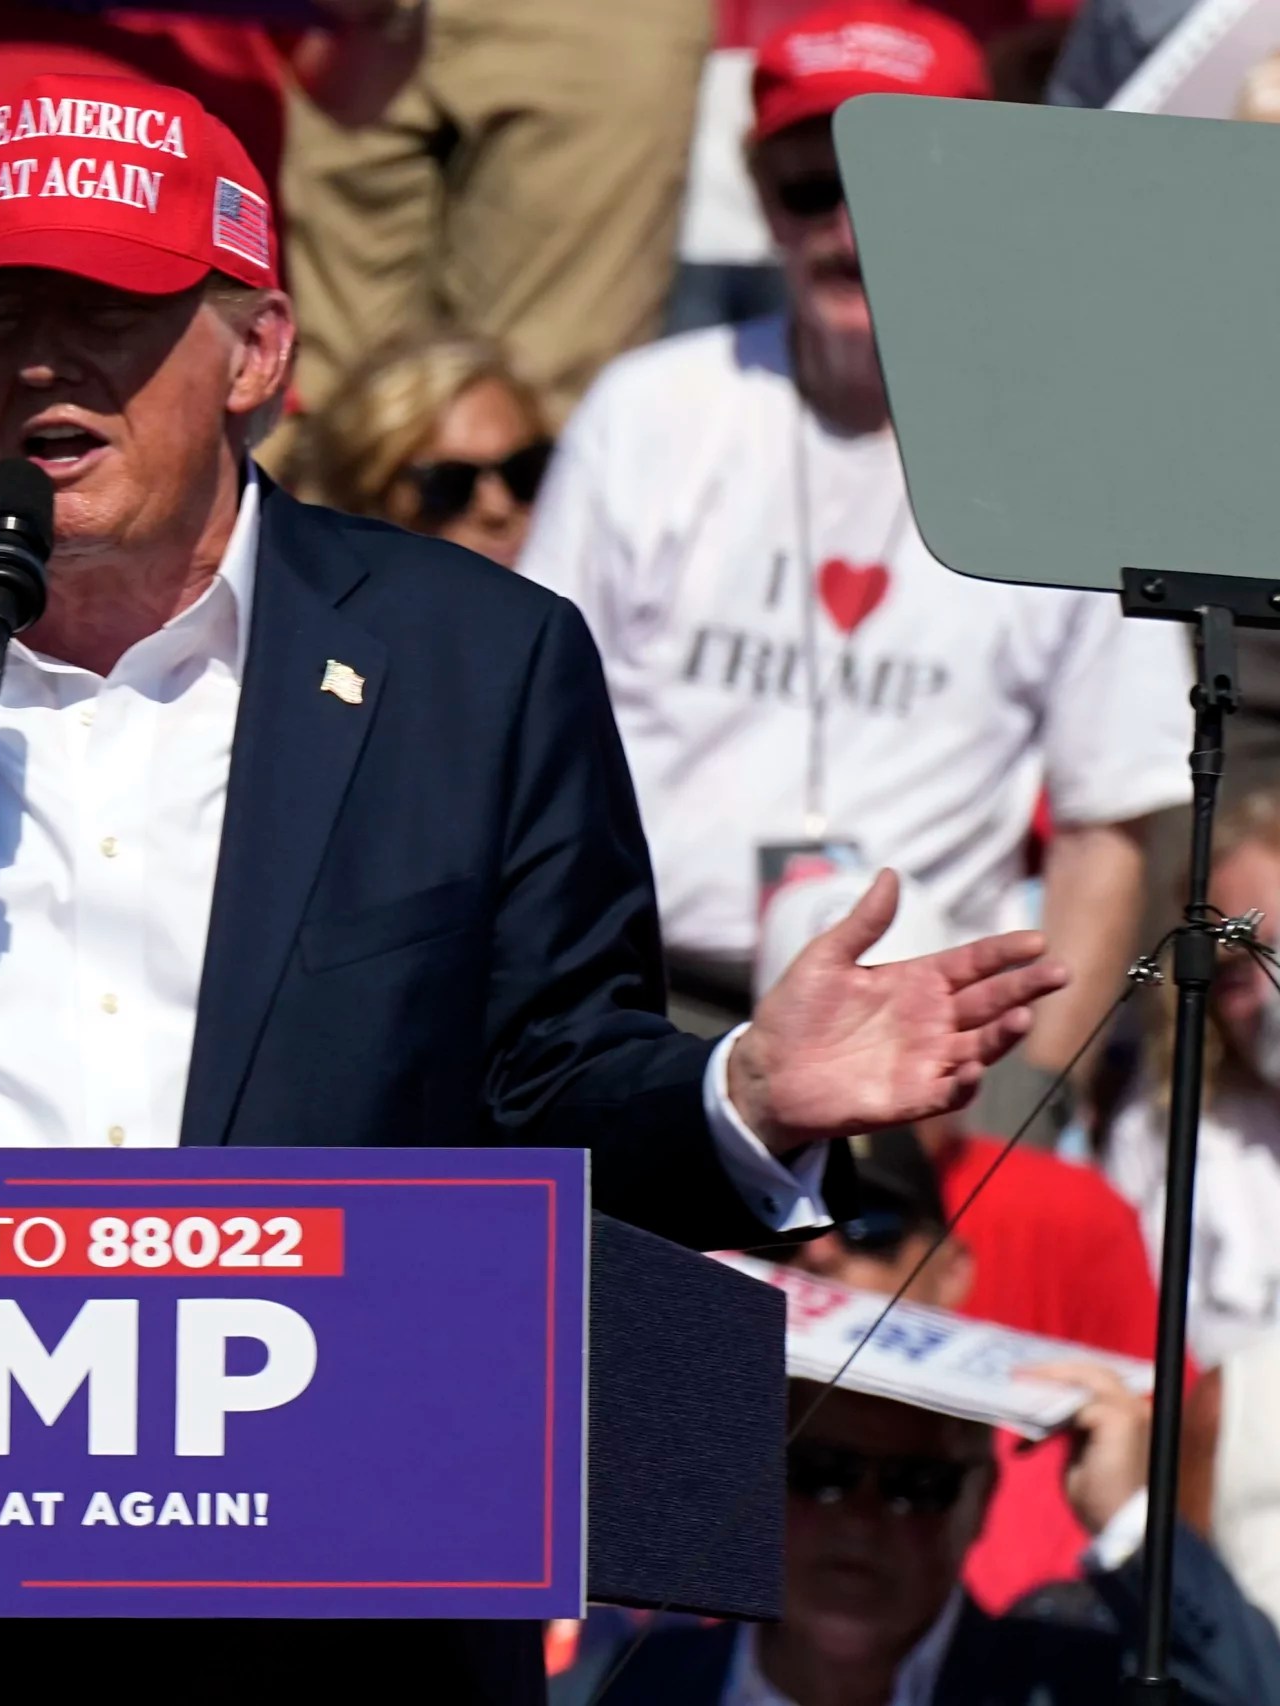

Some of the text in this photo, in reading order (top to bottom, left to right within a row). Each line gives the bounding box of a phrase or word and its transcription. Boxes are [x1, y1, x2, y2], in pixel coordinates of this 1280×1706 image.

[11, 97, 188, 159] AMERICA
[38, 156, 165, 214] AGAIN
[762, 549, 790, 612] I
[681, 622, 952, 716] TRUMP
[87, 1216, 304, 1268] 88022
[81, 1491, 268, 1527] AGAIN!
